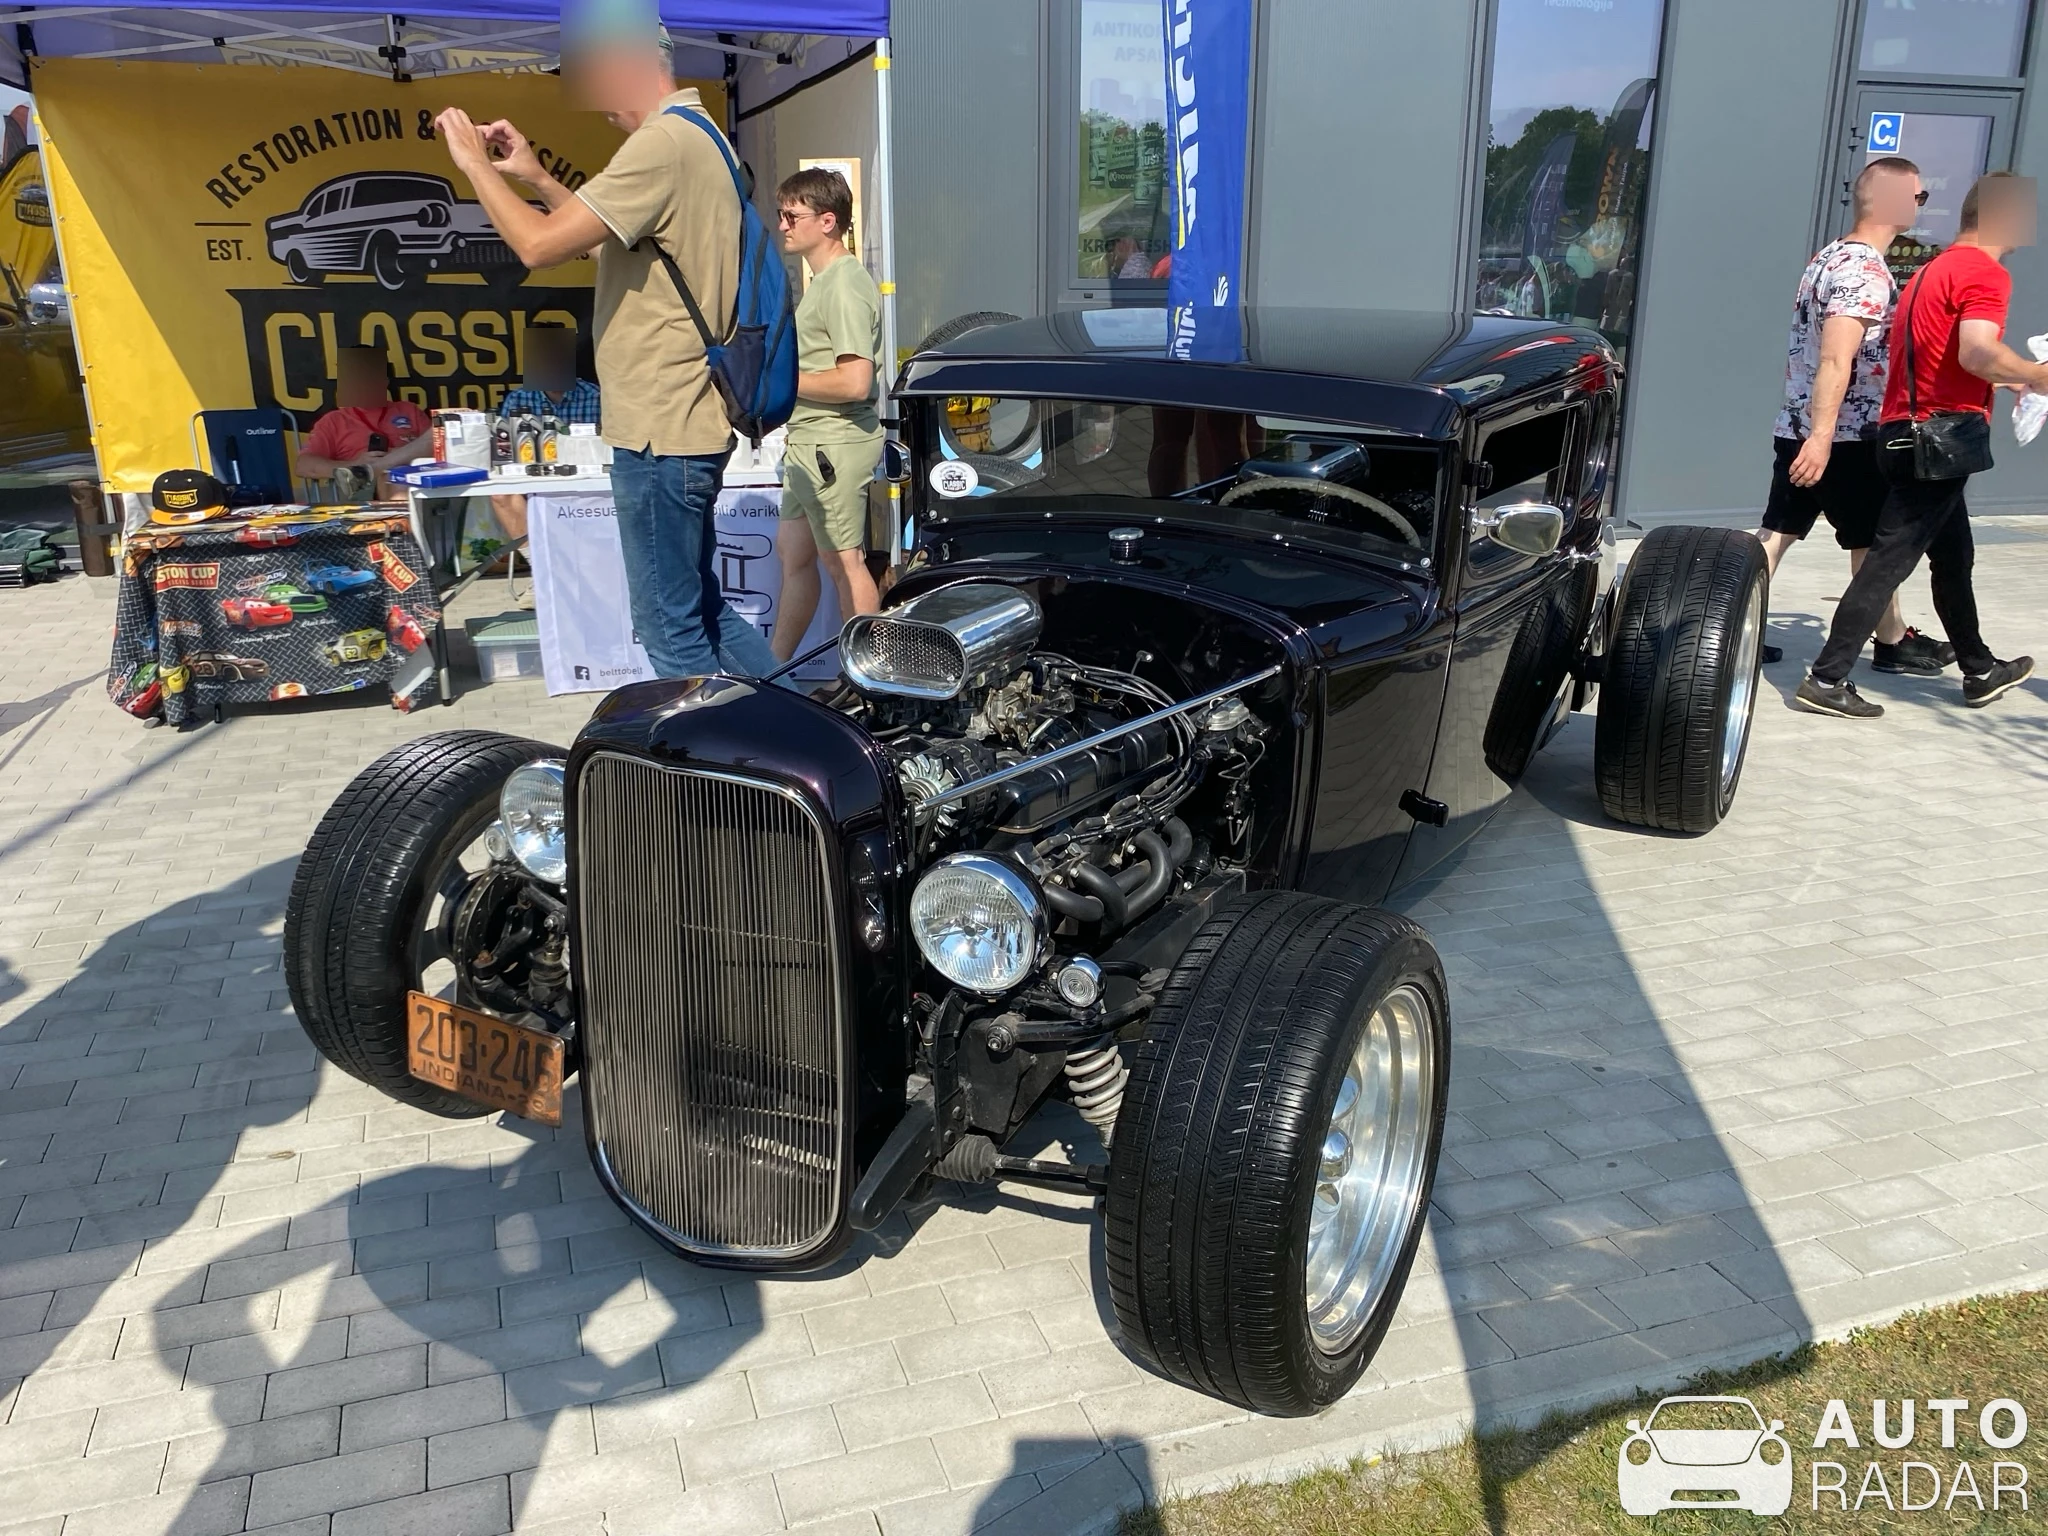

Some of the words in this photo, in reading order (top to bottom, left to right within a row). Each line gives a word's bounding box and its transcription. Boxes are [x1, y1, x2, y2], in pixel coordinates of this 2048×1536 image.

[206, 108, 403, 209] RESTORATION
[417, 108, 437, 141] &
[206, 239, 252, 261] EST.
[264, 308, 580, 412] CLASSI
[557, 505, 617, 519] Aksesua
[741, 504, 782, 518] varikl
[191, 566, 217, 580] CUP
[345, 649, 358, 660] 52
[199, 663, 214, 676] 28
[599, 665, 643, 677] belttobelt
